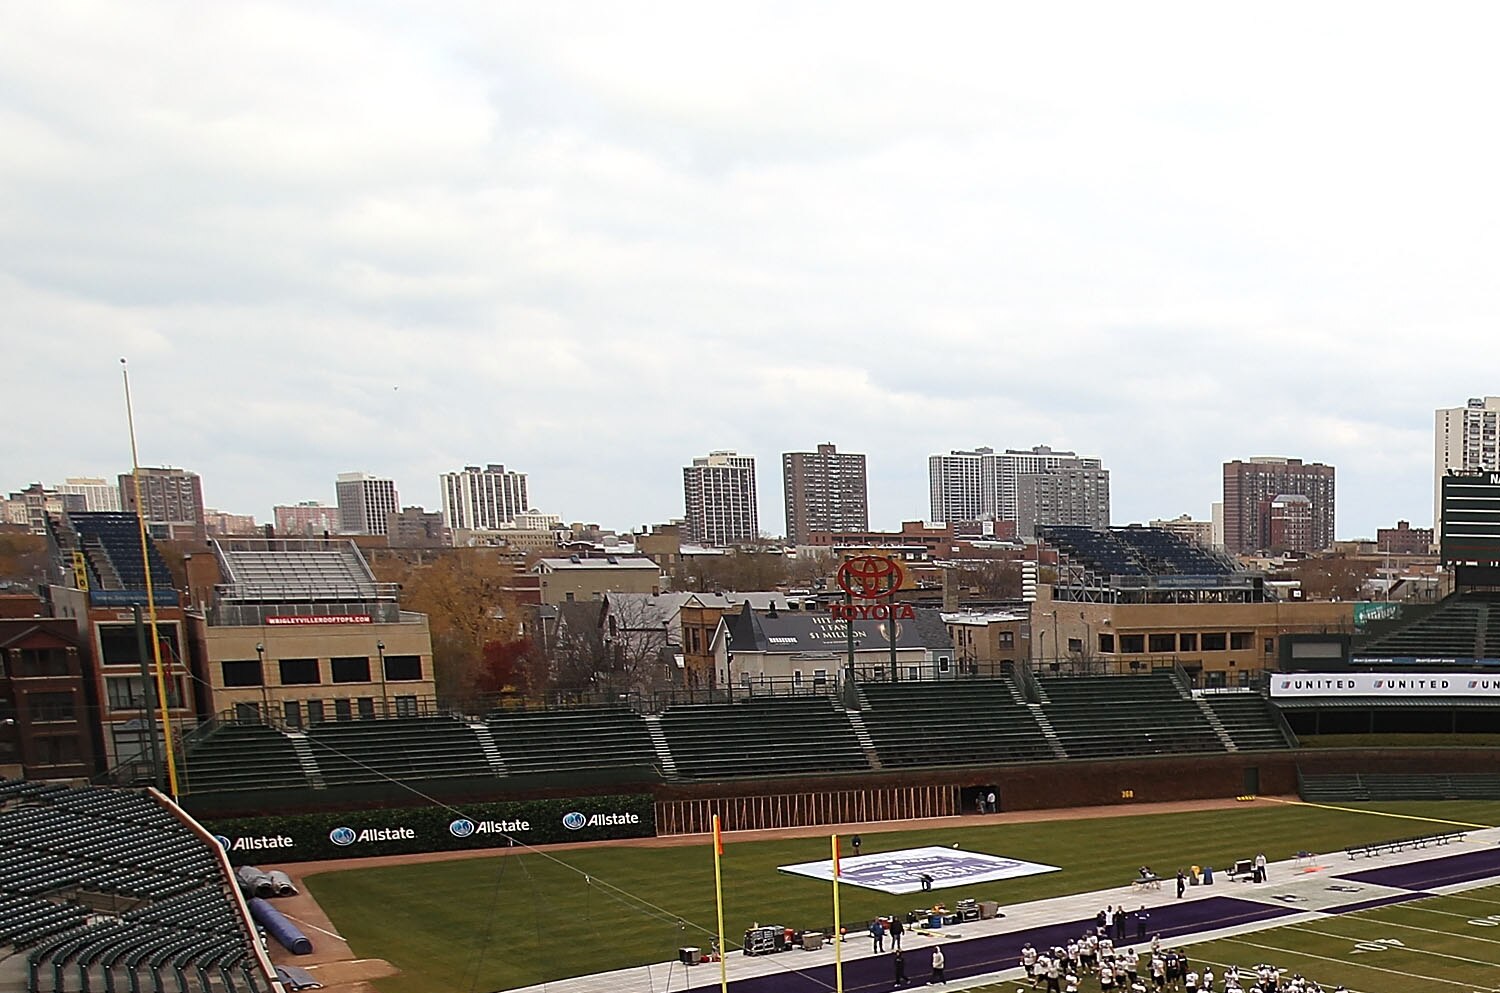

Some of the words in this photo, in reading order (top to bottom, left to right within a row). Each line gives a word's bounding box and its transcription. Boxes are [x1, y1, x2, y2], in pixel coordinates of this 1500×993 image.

[269, 616, 370, 624] WRIGLEYVILLEROOFTOPS.COM
[827, 604, 915, 621] TOYOTA
[822, 630, 867, 639] MILLON
[1294, 680, 1355, 689] UNITED
[1387, 680, 1449, 689] UNITED
[475, 819, 529, 835] Allstate
[587, 811, 639, 827] Allstate
[233, 835, 293, 851] Allstate
[356, 827, 415, 843] Allstate
